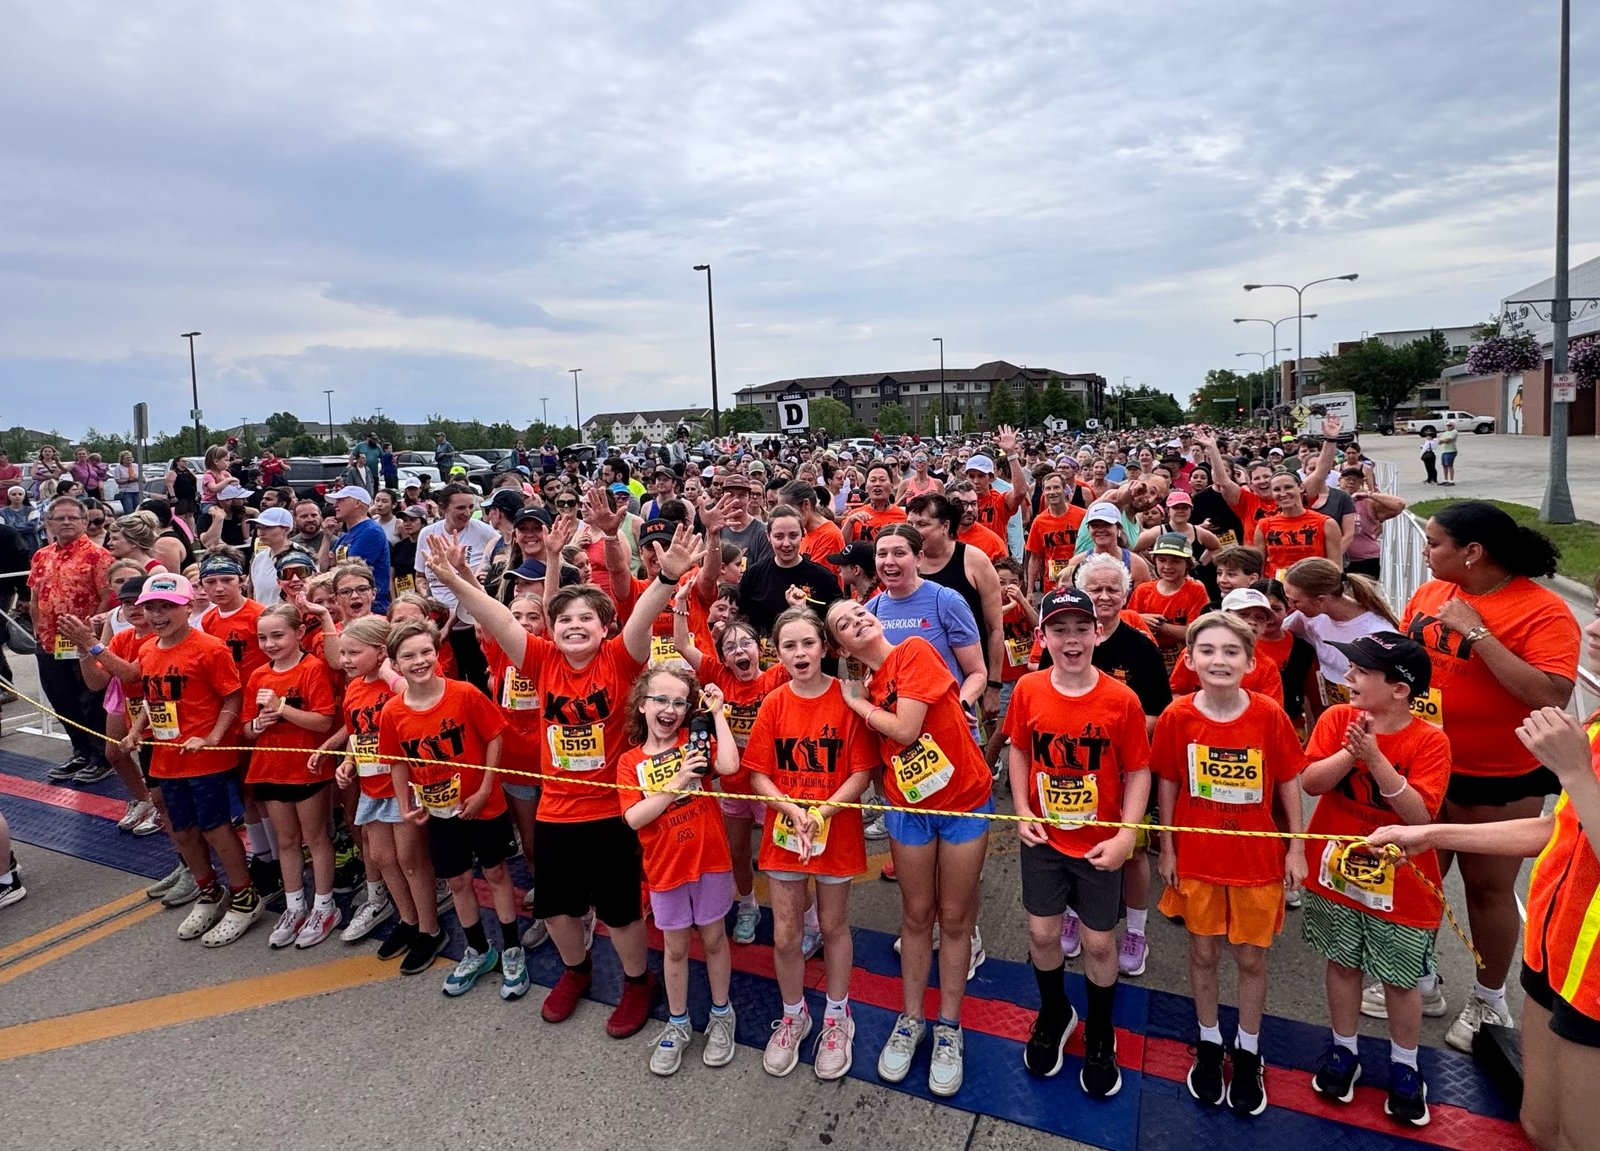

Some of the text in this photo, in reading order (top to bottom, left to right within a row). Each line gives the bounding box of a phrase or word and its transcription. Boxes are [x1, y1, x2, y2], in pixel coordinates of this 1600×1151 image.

[784, 403, 803, 426] D
[1056, 421, 1064, 430] F
[655, 644, 677, 656] 158
[559, 738, 597, 751] 15191
[647, 761, 682, 786] 1554
[898, 750, 940, 783] 15979
[1200, 761, 1258, 780] 16226
[418, 788, 459, 804] 16362
[909, 790, 918, 799] D
[1046, 789, 1093, 805] 17372
[1201, 785, 1207, 793] F
